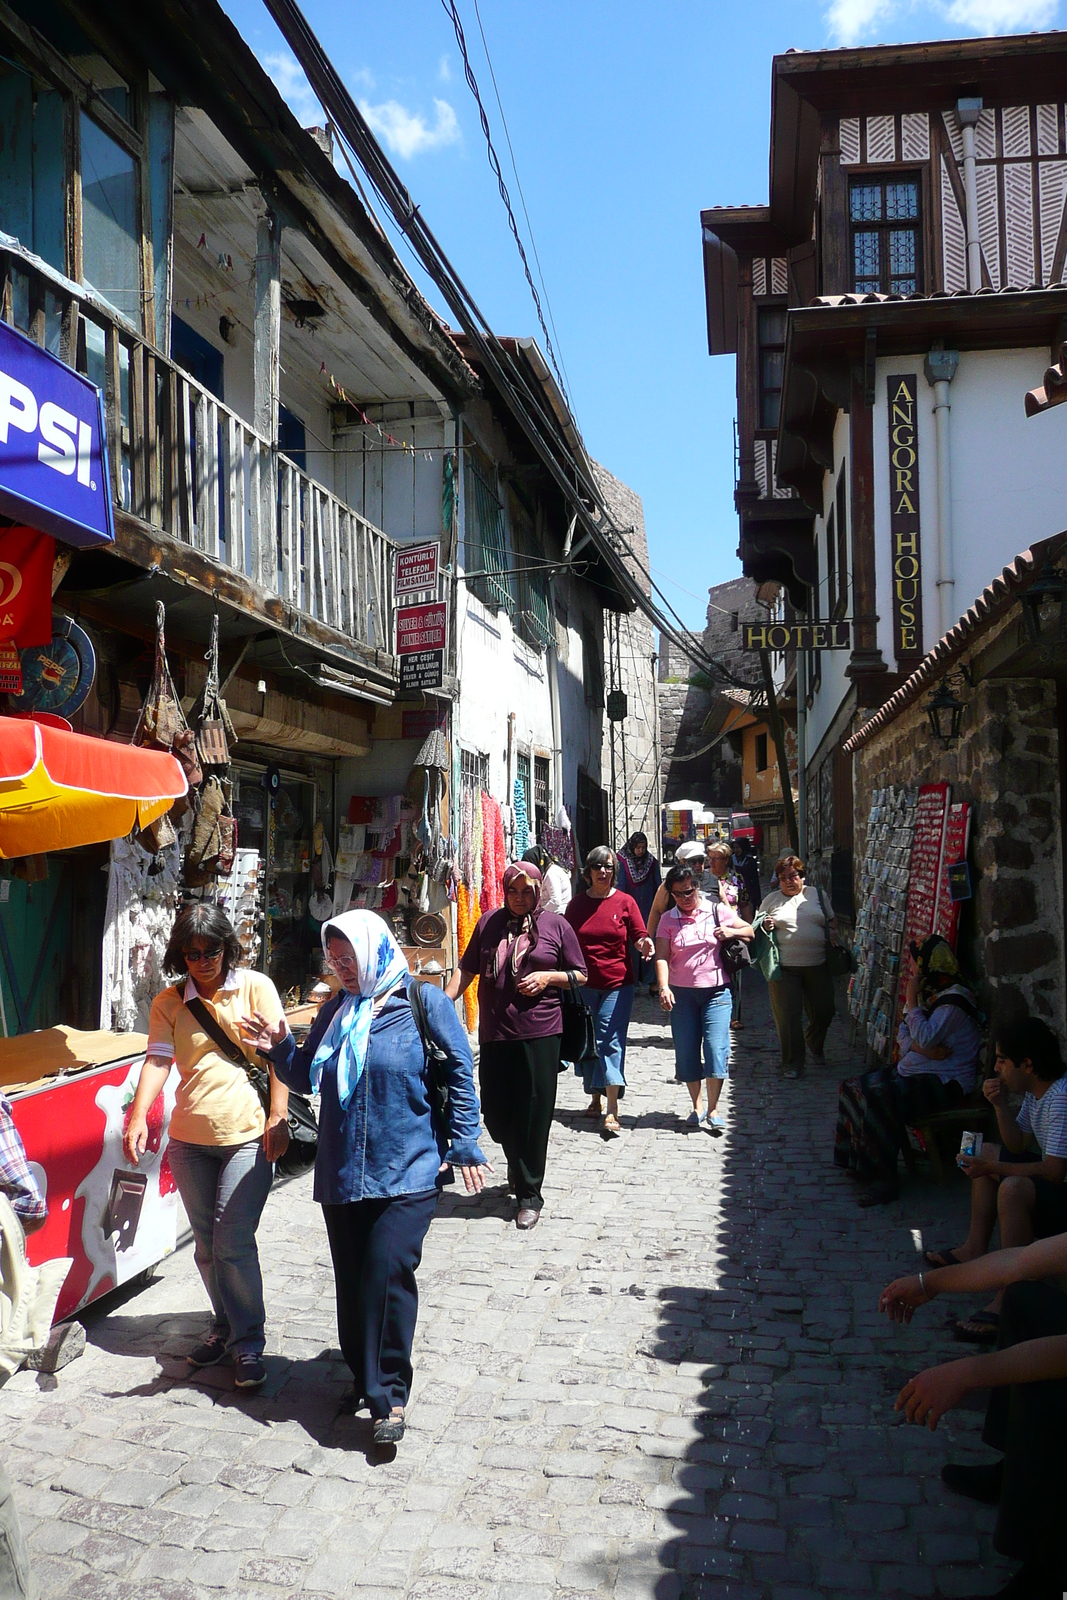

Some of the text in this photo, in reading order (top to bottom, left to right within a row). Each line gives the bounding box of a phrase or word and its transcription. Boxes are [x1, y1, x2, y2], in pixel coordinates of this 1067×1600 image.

[891, 380, 920, 650] ANGORA HOUSE
[401, 563, 430, 577] TELEFON
[746, 624, 850, 649] HOTEL
[37, 654, 67, 677] PEPSI
